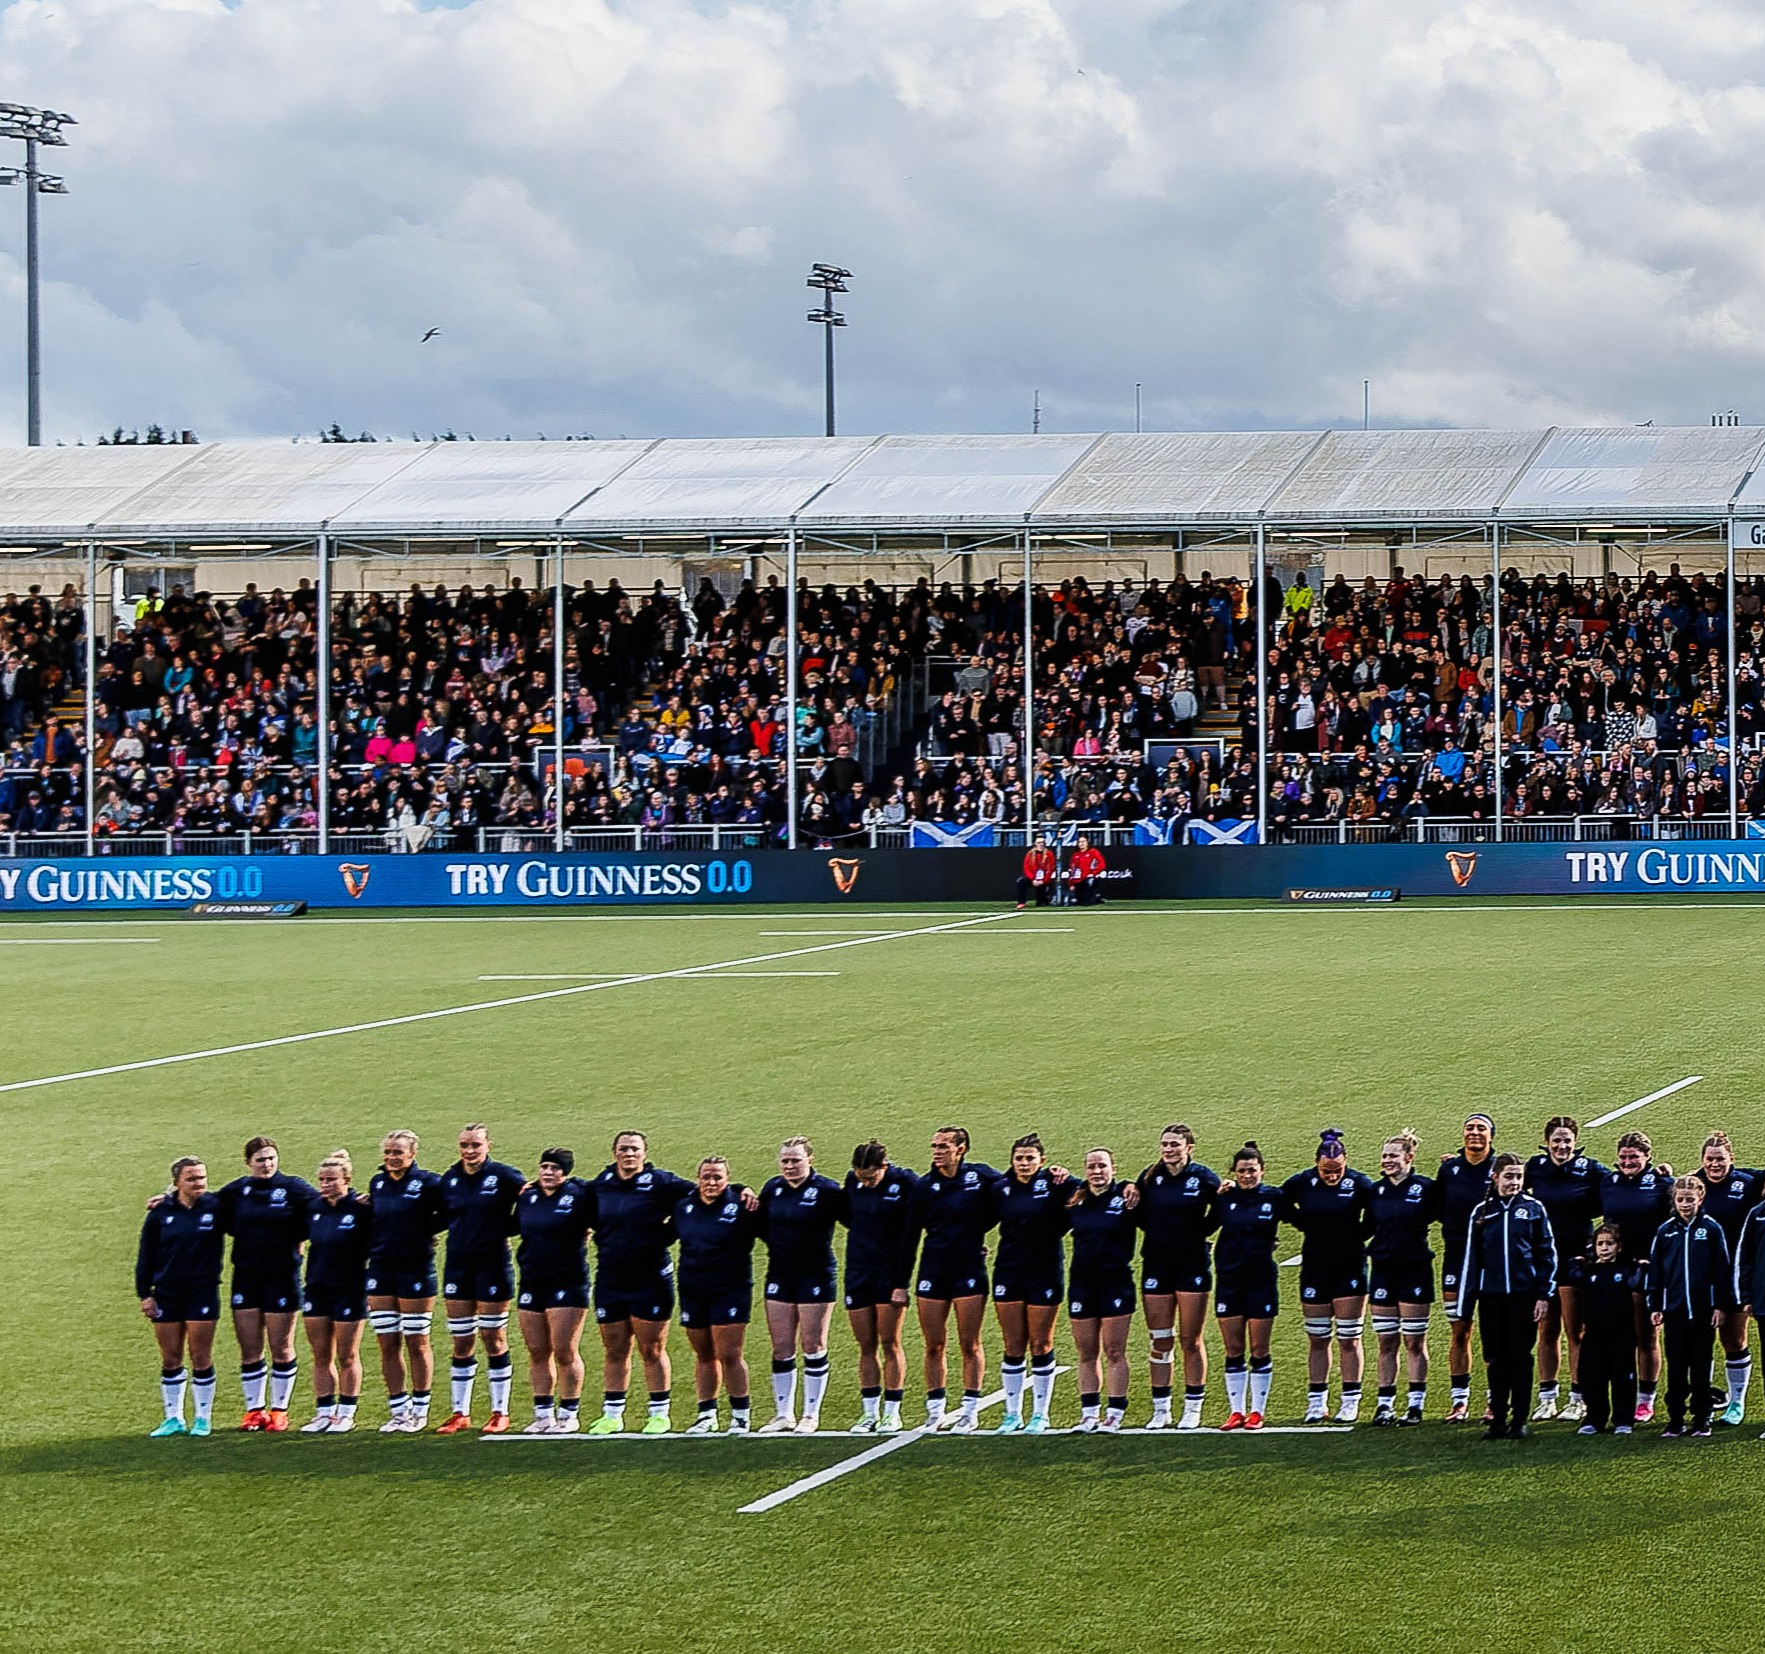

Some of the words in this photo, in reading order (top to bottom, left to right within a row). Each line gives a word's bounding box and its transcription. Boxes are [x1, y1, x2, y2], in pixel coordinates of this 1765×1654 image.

[26, 865, 213, 902] GUINNESS
[218, 865, 264, 899] 0.0
[445, 863, 510, 895] TRY
[516, 859, 702, 897] GUINNESS
[706, 859, 753, 893] 0.0
[1565, 850, 1630, 884] TRY
